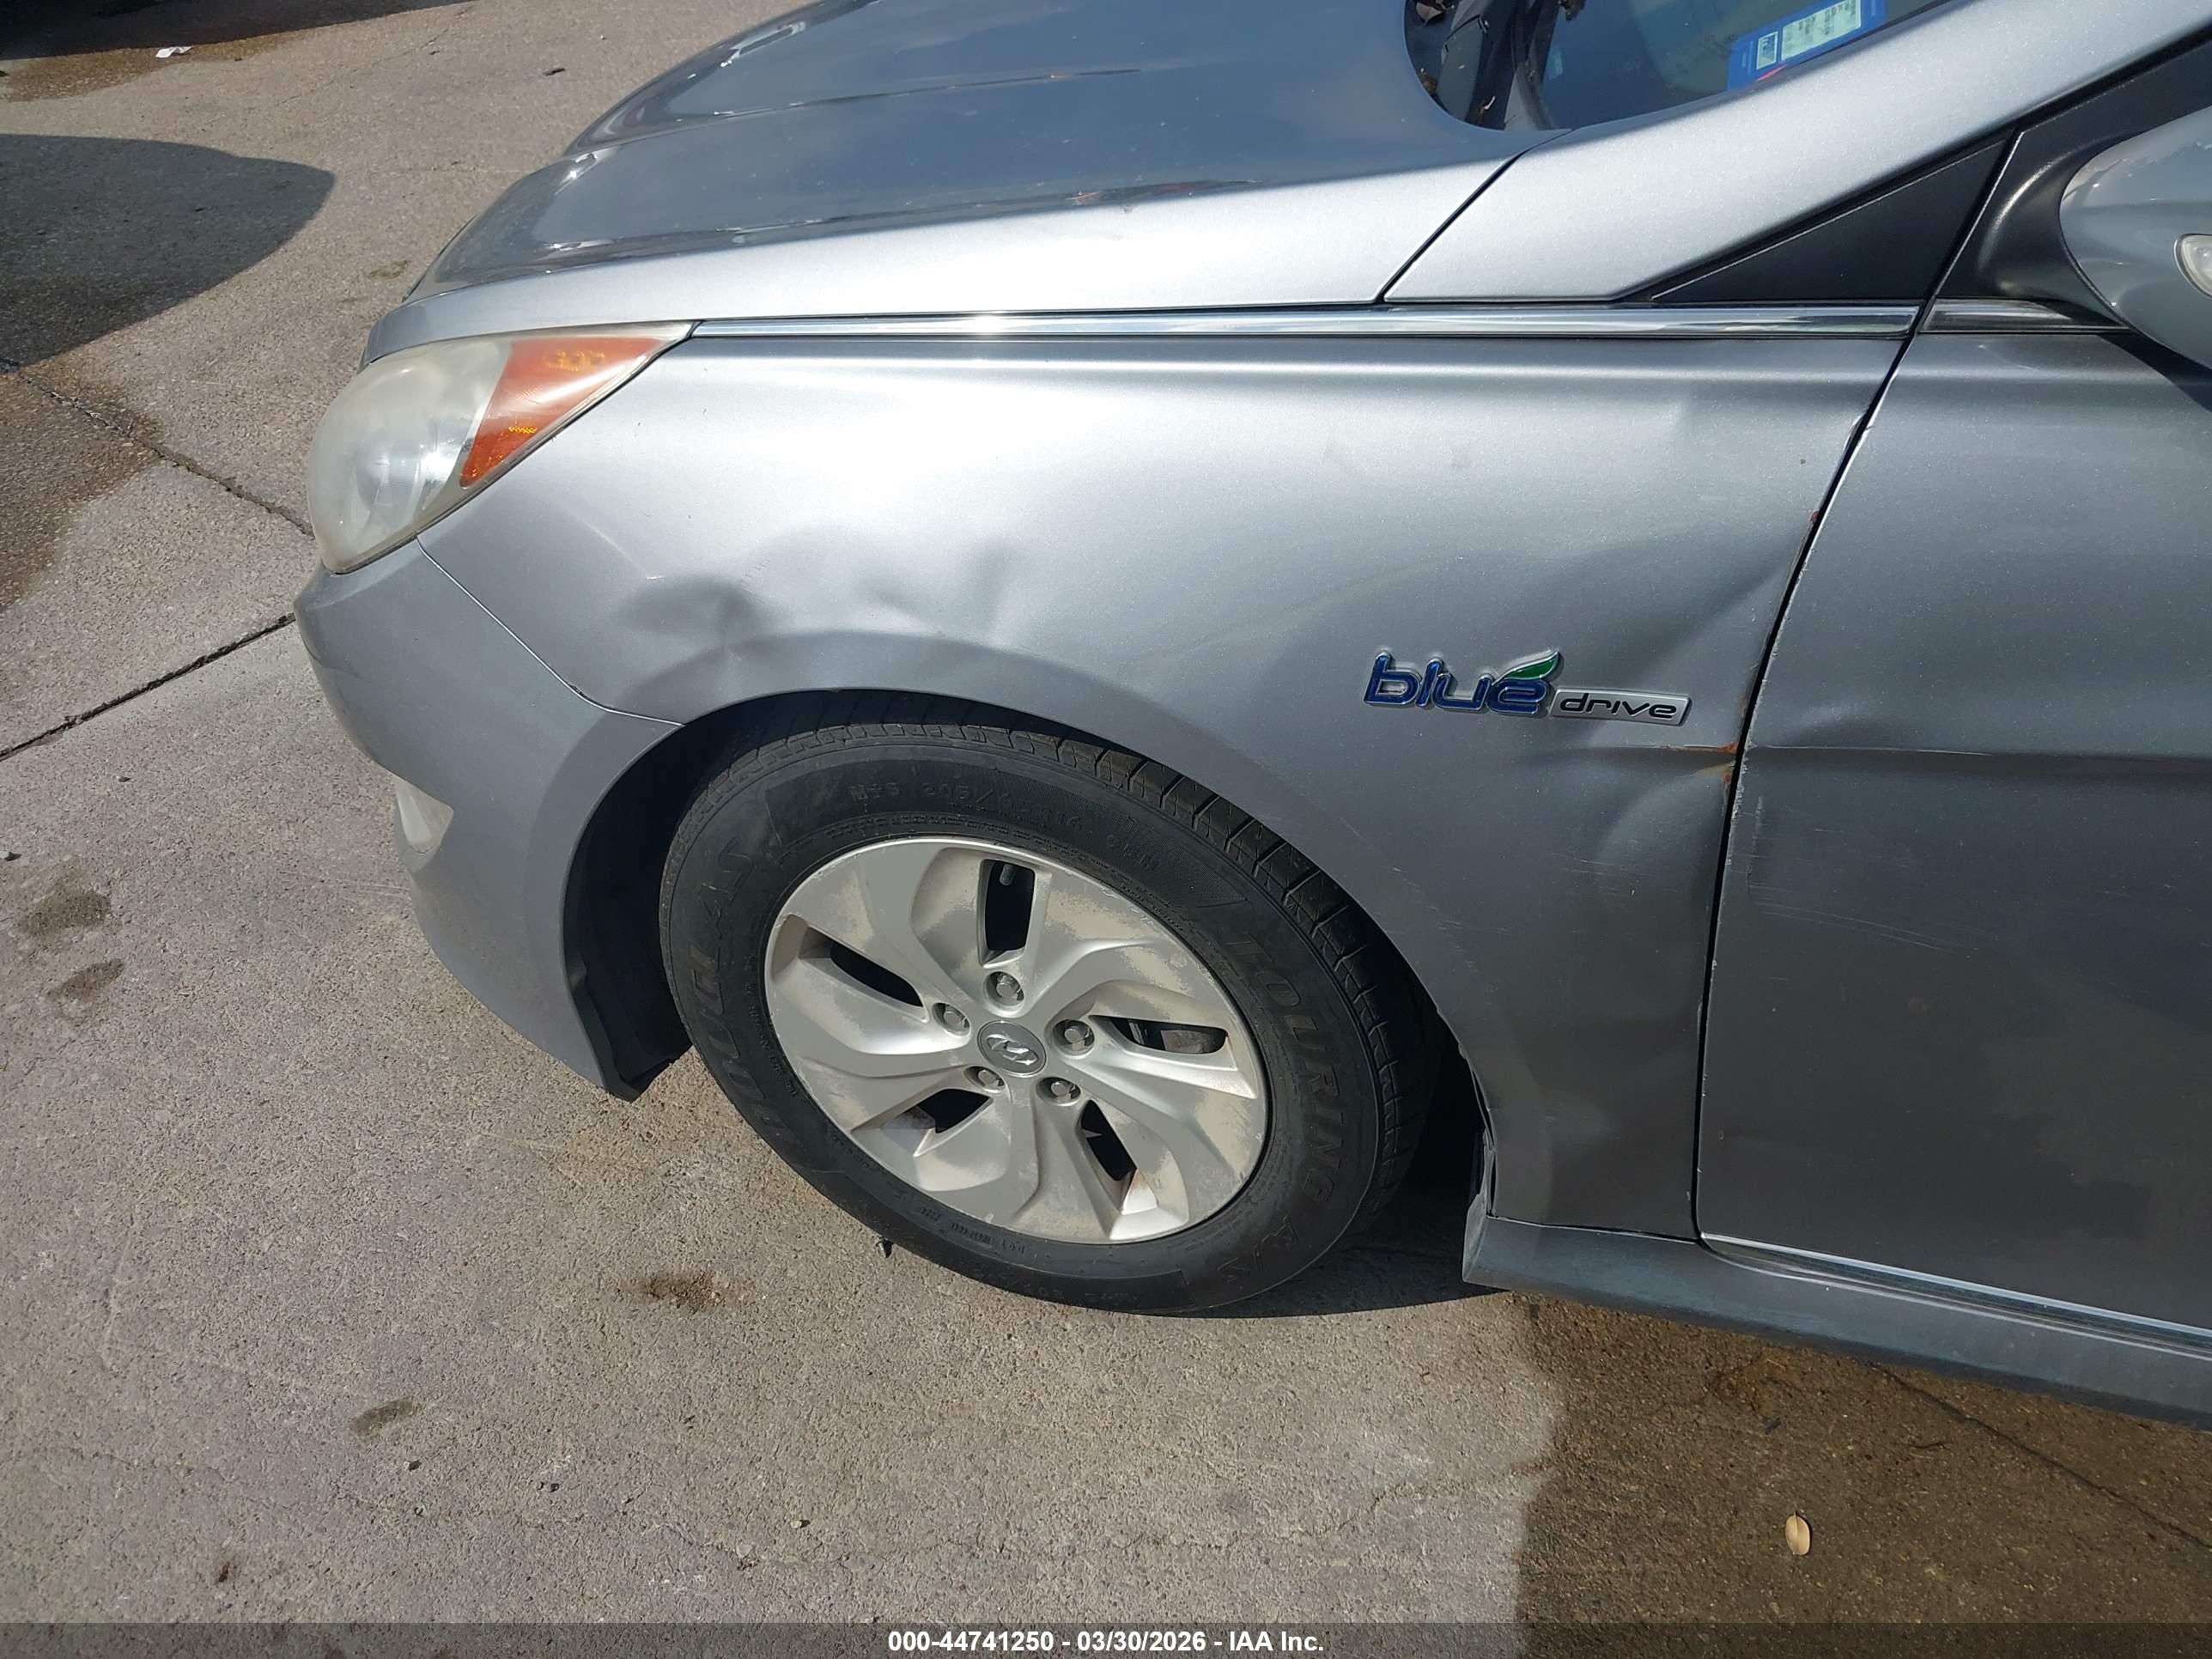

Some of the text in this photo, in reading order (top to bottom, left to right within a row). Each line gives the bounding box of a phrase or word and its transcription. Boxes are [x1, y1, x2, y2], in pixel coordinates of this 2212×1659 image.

[1364, 650, 1678, 720] blue drive
[1226, 927, 1346, 1202] TOURING
